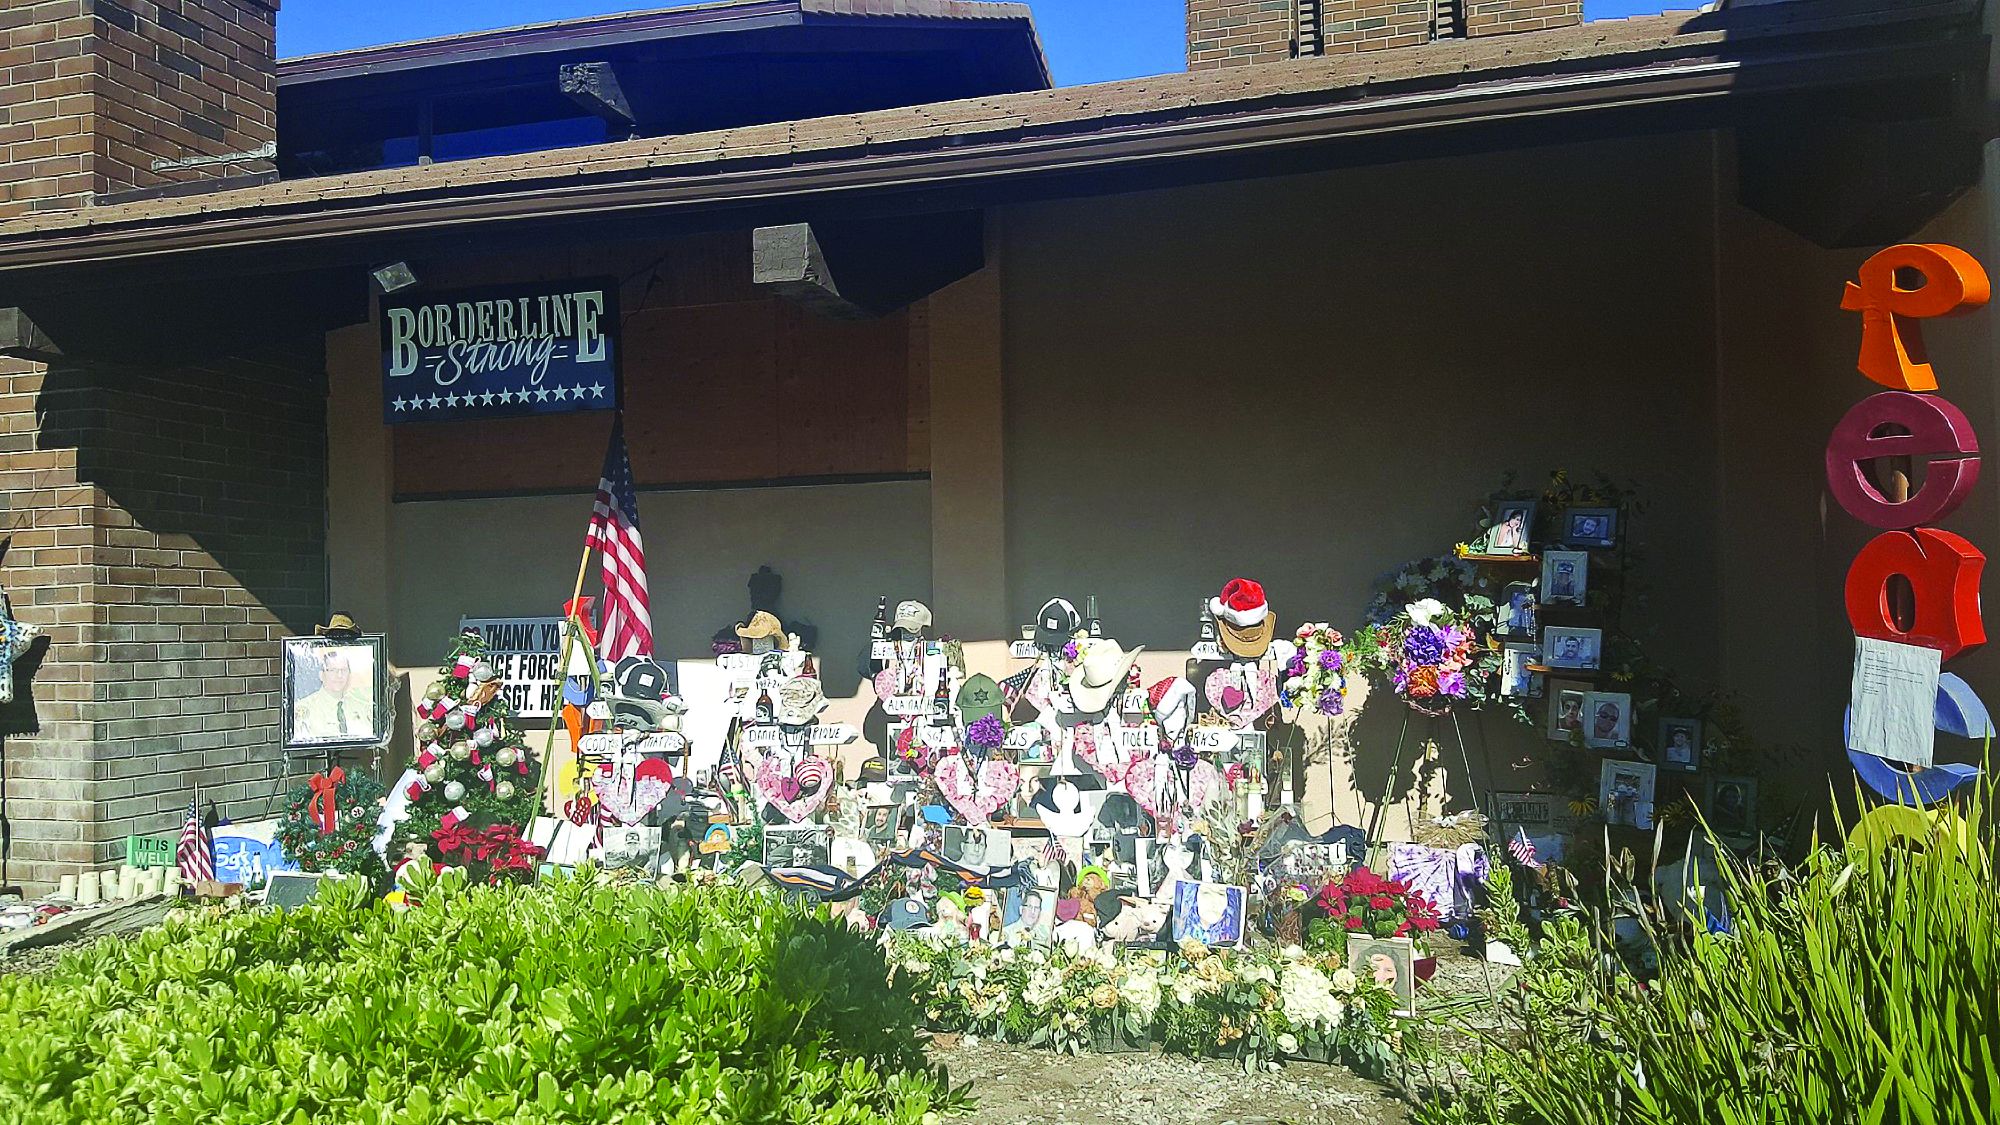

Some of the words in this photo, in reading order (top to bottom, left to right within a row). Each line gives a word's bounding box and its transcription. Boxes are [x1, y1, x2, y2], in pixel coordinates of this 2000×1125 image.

[387, 290, 606, 377] BORDERLINE
[434, 333, 556, 386] Strong
[486, 624, 535, 651] THANK
[541, 624, 560, 651] YO
[490, 654, 513, 680] ICE
[519, 654, 559, 681] FORC
[502, 684, 534, 711] SGT.
[540, 684, 564, 711] HE
[1122, 731, 1154, 748] NOEL
[139, 838, 152, 850] IT
[156, 839, 168, 851] IS
[135, 851, 173, 866] WELL
